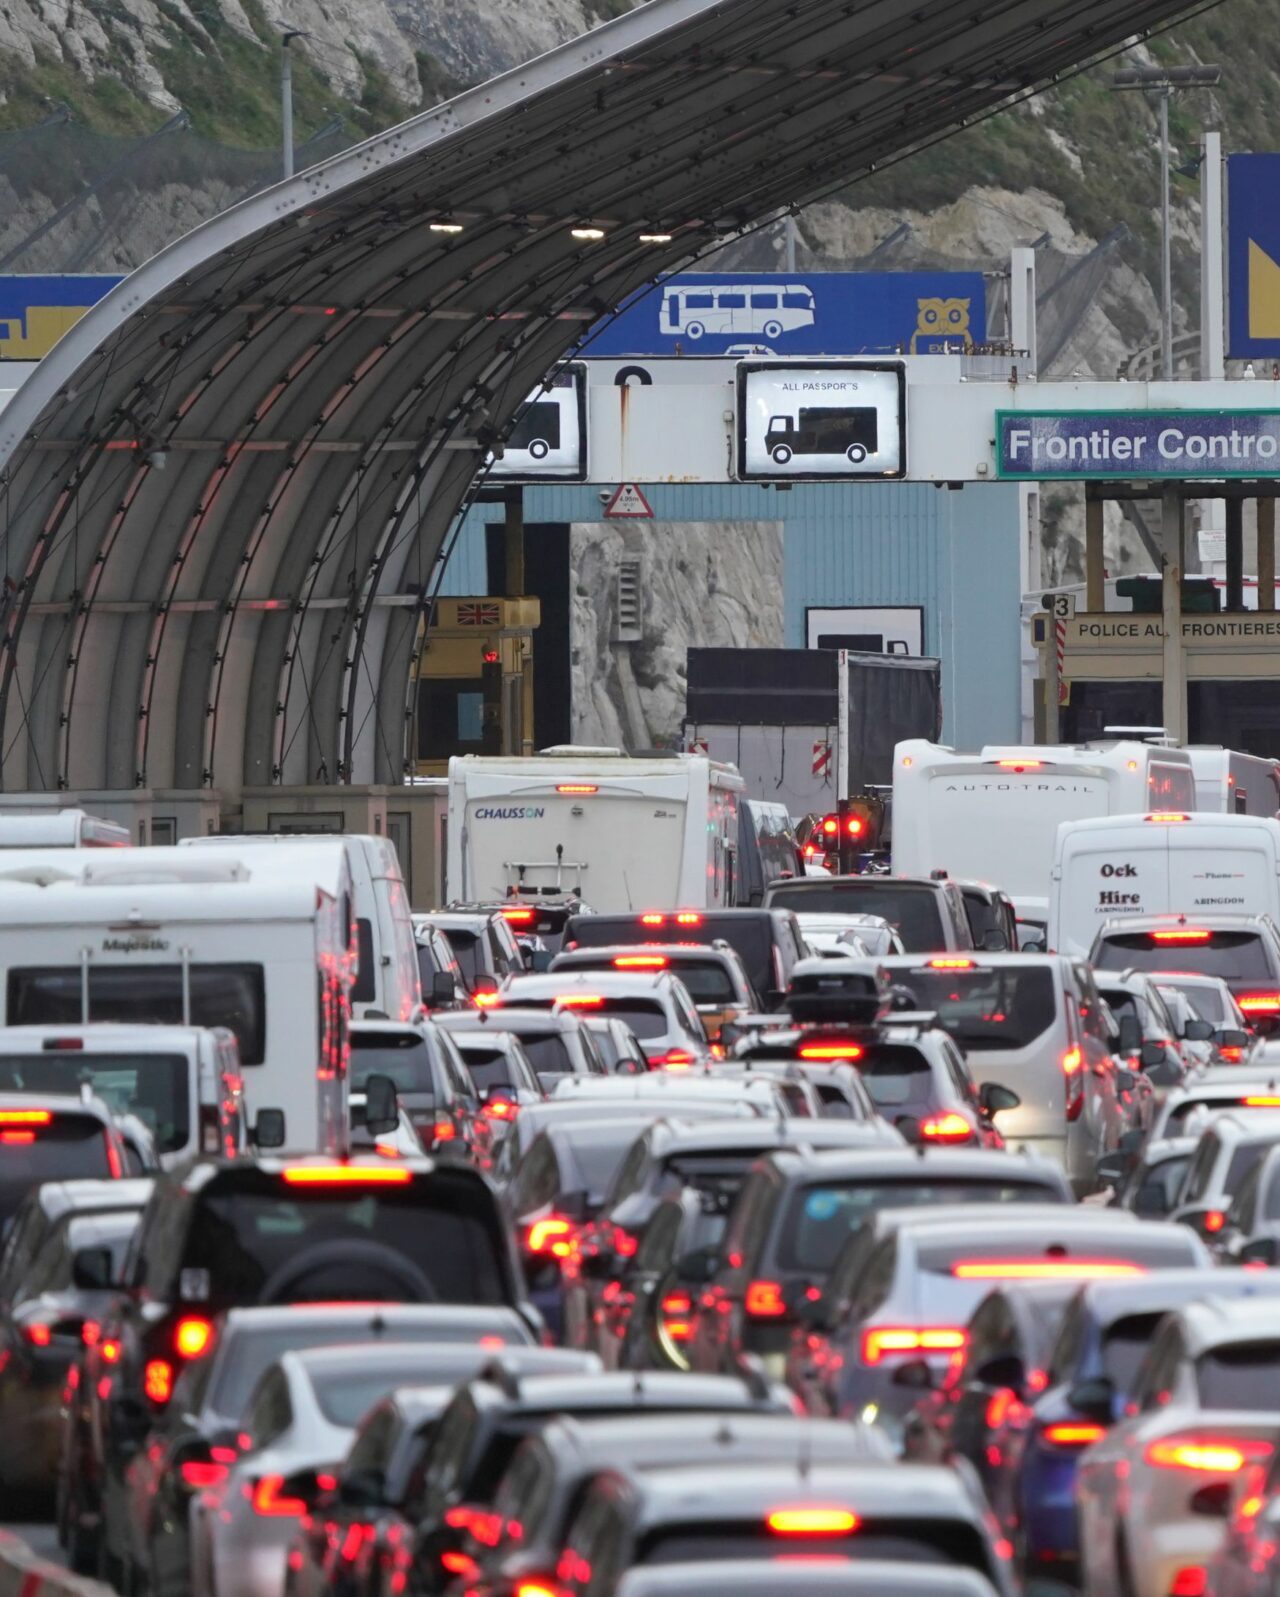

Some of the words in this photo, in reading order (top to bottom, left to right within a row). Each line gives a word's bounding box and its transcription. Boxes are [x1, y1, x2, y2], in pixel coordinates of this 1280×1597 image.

[782, 382, 800, 391] ALL
[802, 382, 859, 391] PASSPORS
[1010, 429, 1147, 460] Frontier
[1055, 597, 1069, 617] 3
[1079, 623, 1139, 637] POLICE
[1144, 623, 1165, 637] AU
[946, 784, 1094, 793] AUTO-TRAIL
[475, 807, 545, 820] CHAUSSON
[1101, 863, 1138, 878] Ock
[1099, 891, 1141, 905] Hire
[102, 938, 169, 954] Majestic
